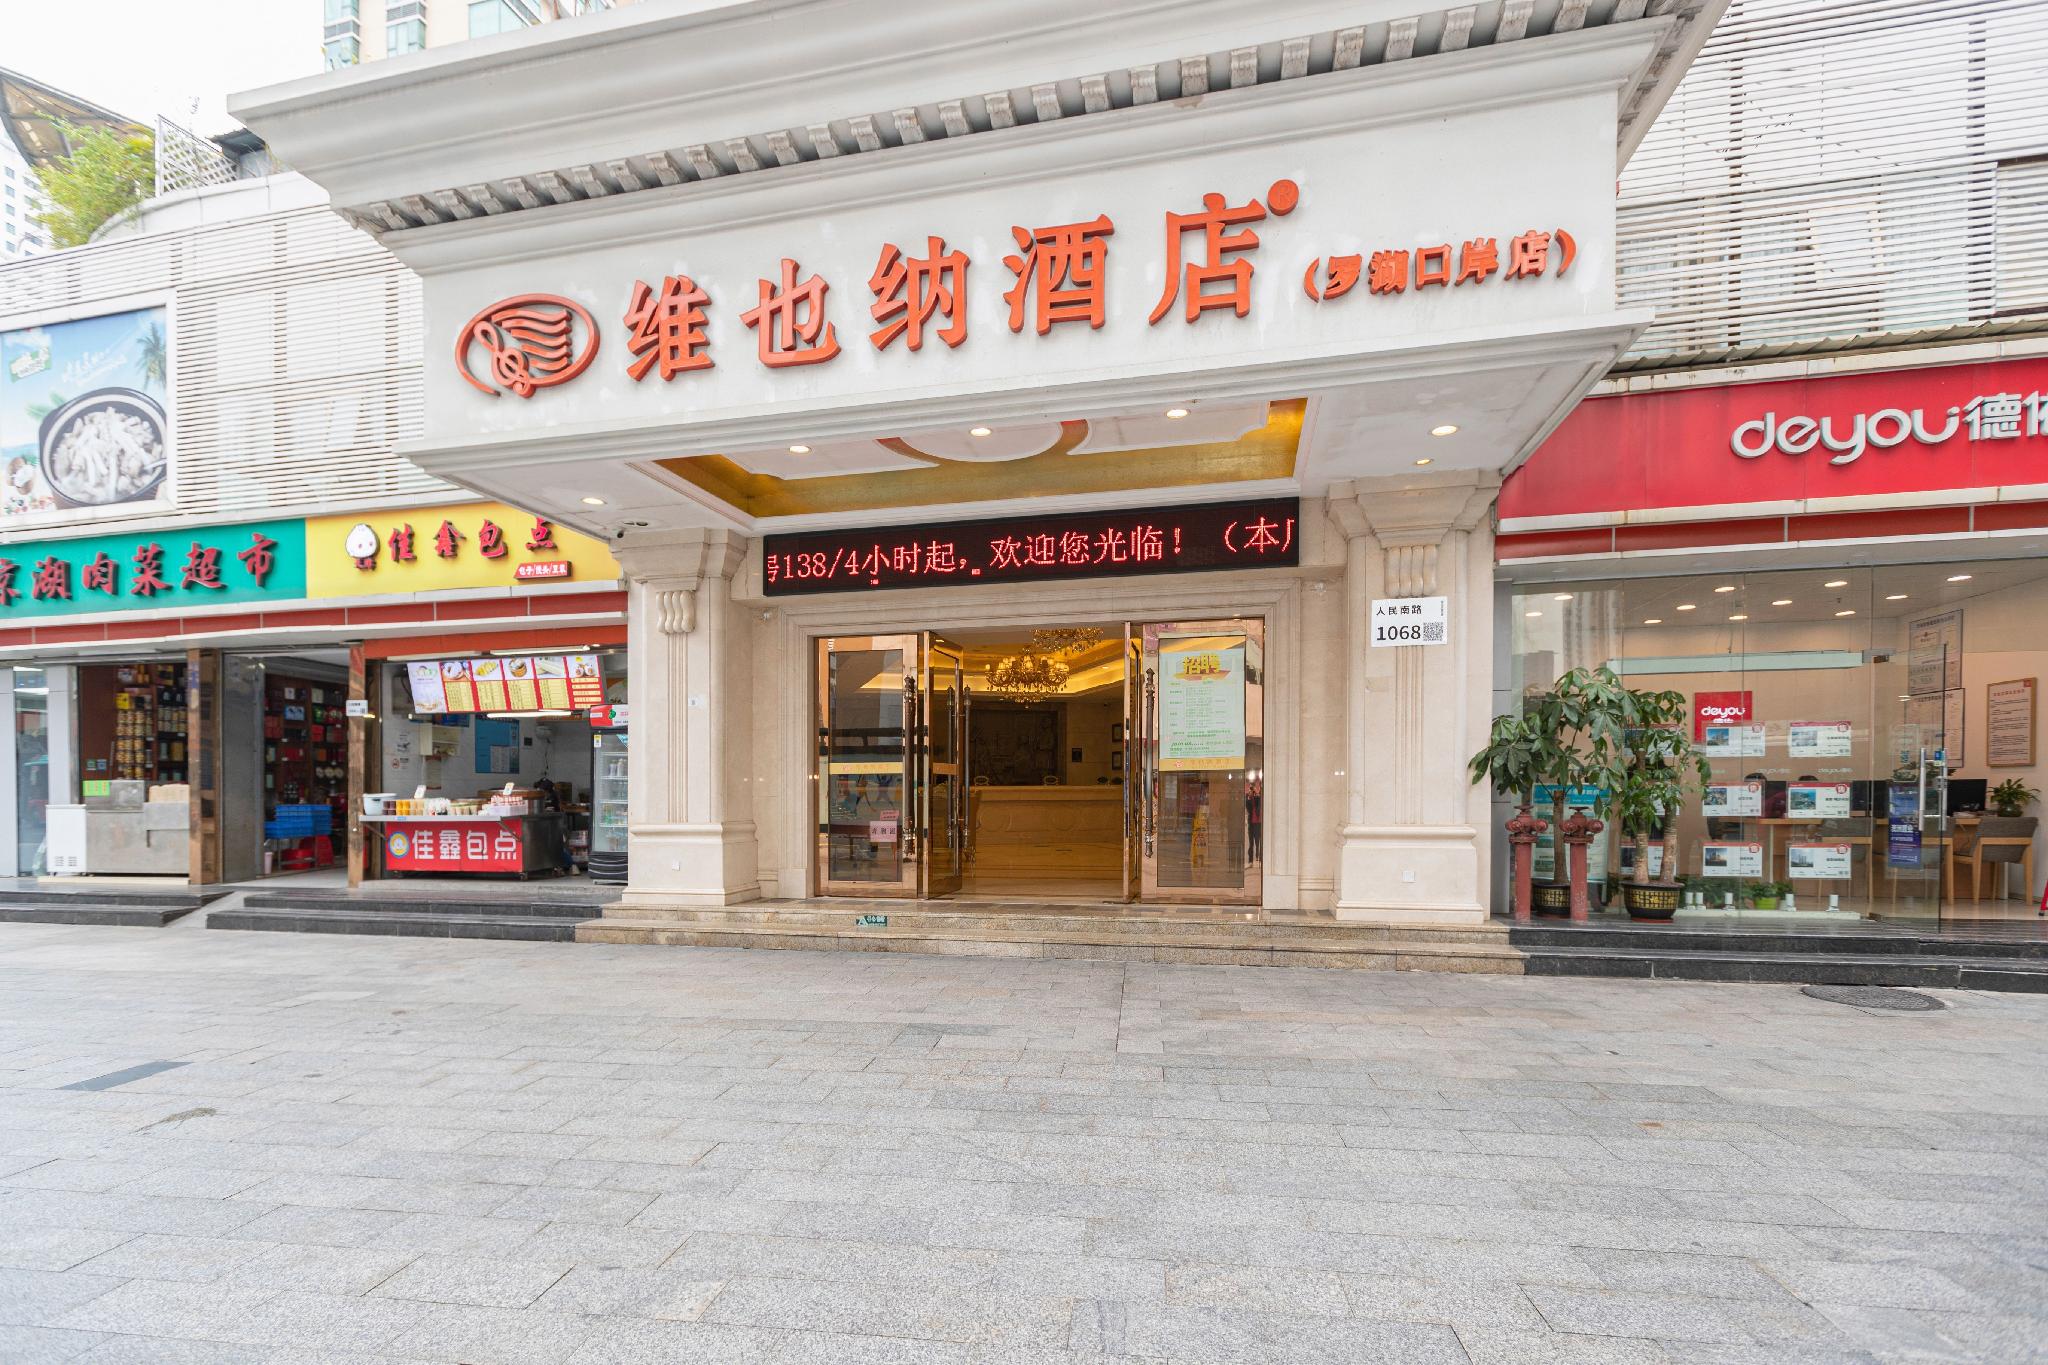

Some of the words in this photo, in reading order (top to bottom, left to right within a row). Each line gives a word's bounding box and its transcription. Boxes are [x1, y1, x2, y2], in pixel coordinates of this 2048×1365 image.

[624, 193, 1267, 381] 维也纳酒店
[388, 517, 558, 562] 佳鑫包点
[1376, 604, 1422, 616] 人民南路
[1376, 625, 1421, 641] 1068
[1183, 653, 1220, 675] 招聘
[412, 830, 517, 860] 佳鑫包点
